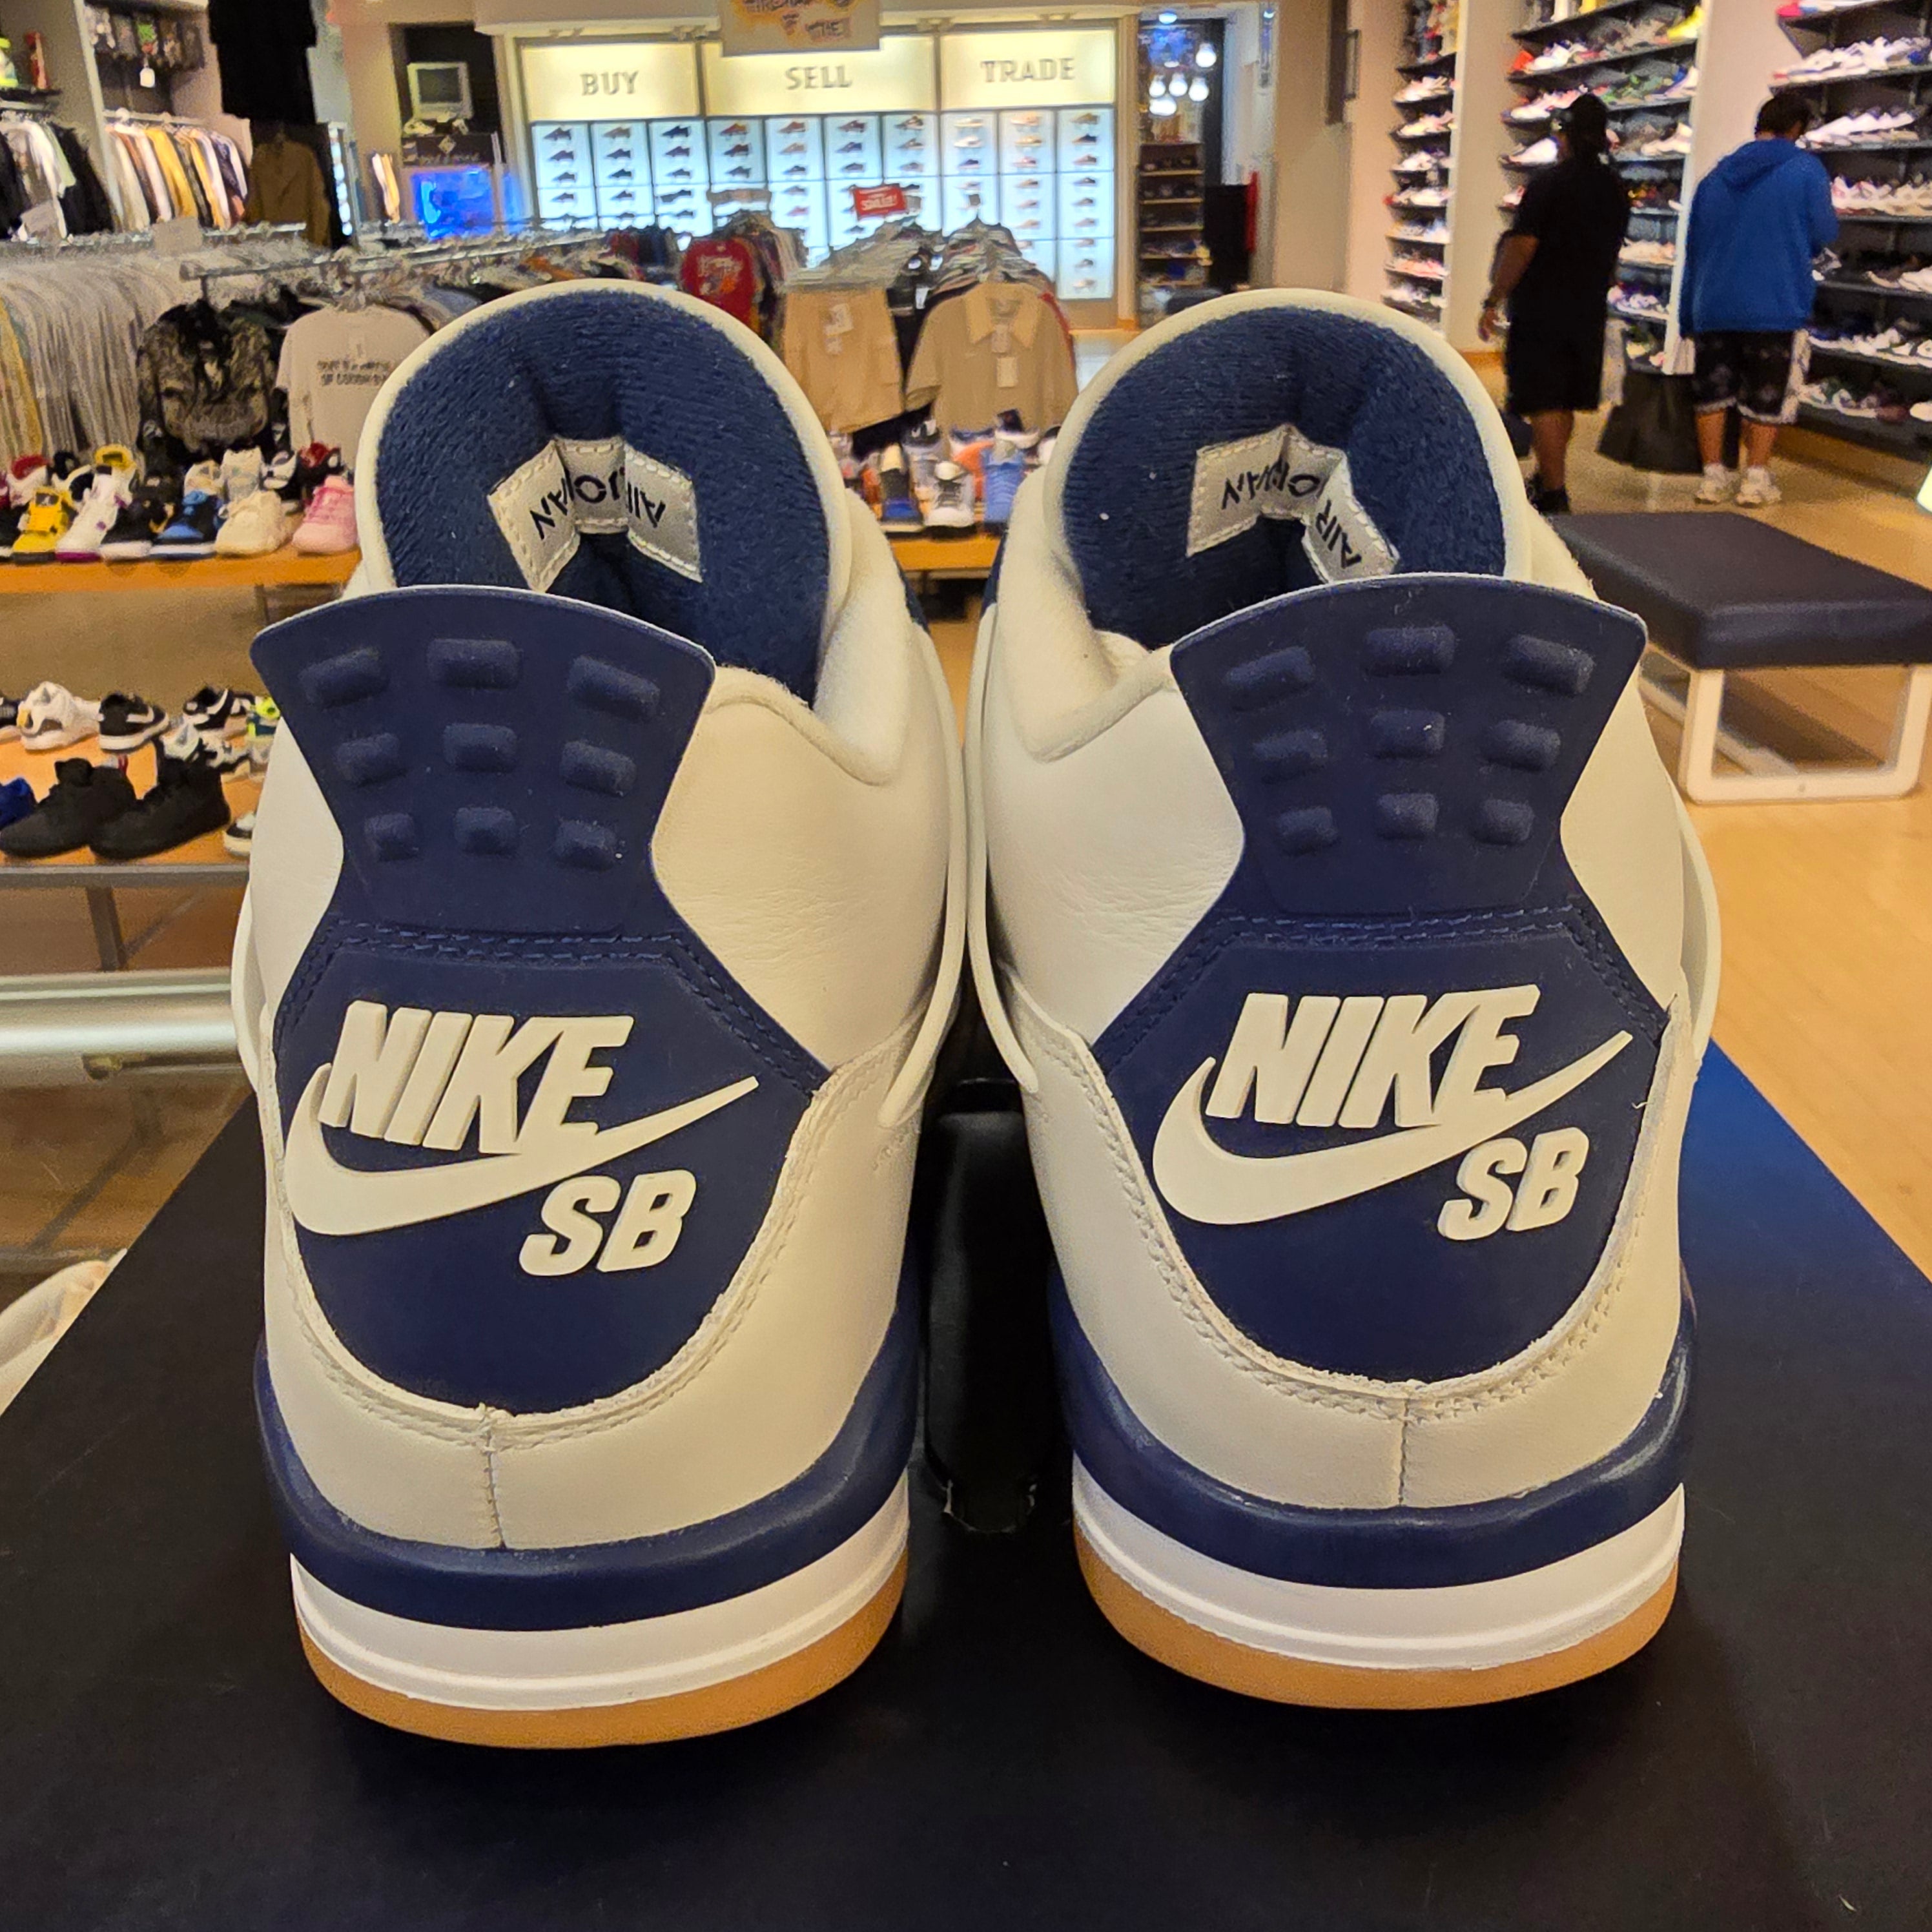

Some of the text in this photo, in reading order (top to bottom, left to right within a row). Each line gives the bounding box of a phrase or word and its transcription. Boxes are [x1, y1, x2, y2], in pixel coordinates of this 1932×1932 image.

[580, 70, 639, 97] BUY
[785, 65, 854, 91] SELL
[979, 57, 1076, 83] TRADE
[1315, 499, 1362, 570] AIR
[317, 999, 635, 1156] NIKE
[1205, 983, 1541, 1129] NIKE
[519, 1168, 697, 1277] SB
[1437, 1126, 1590, 1242] SB
